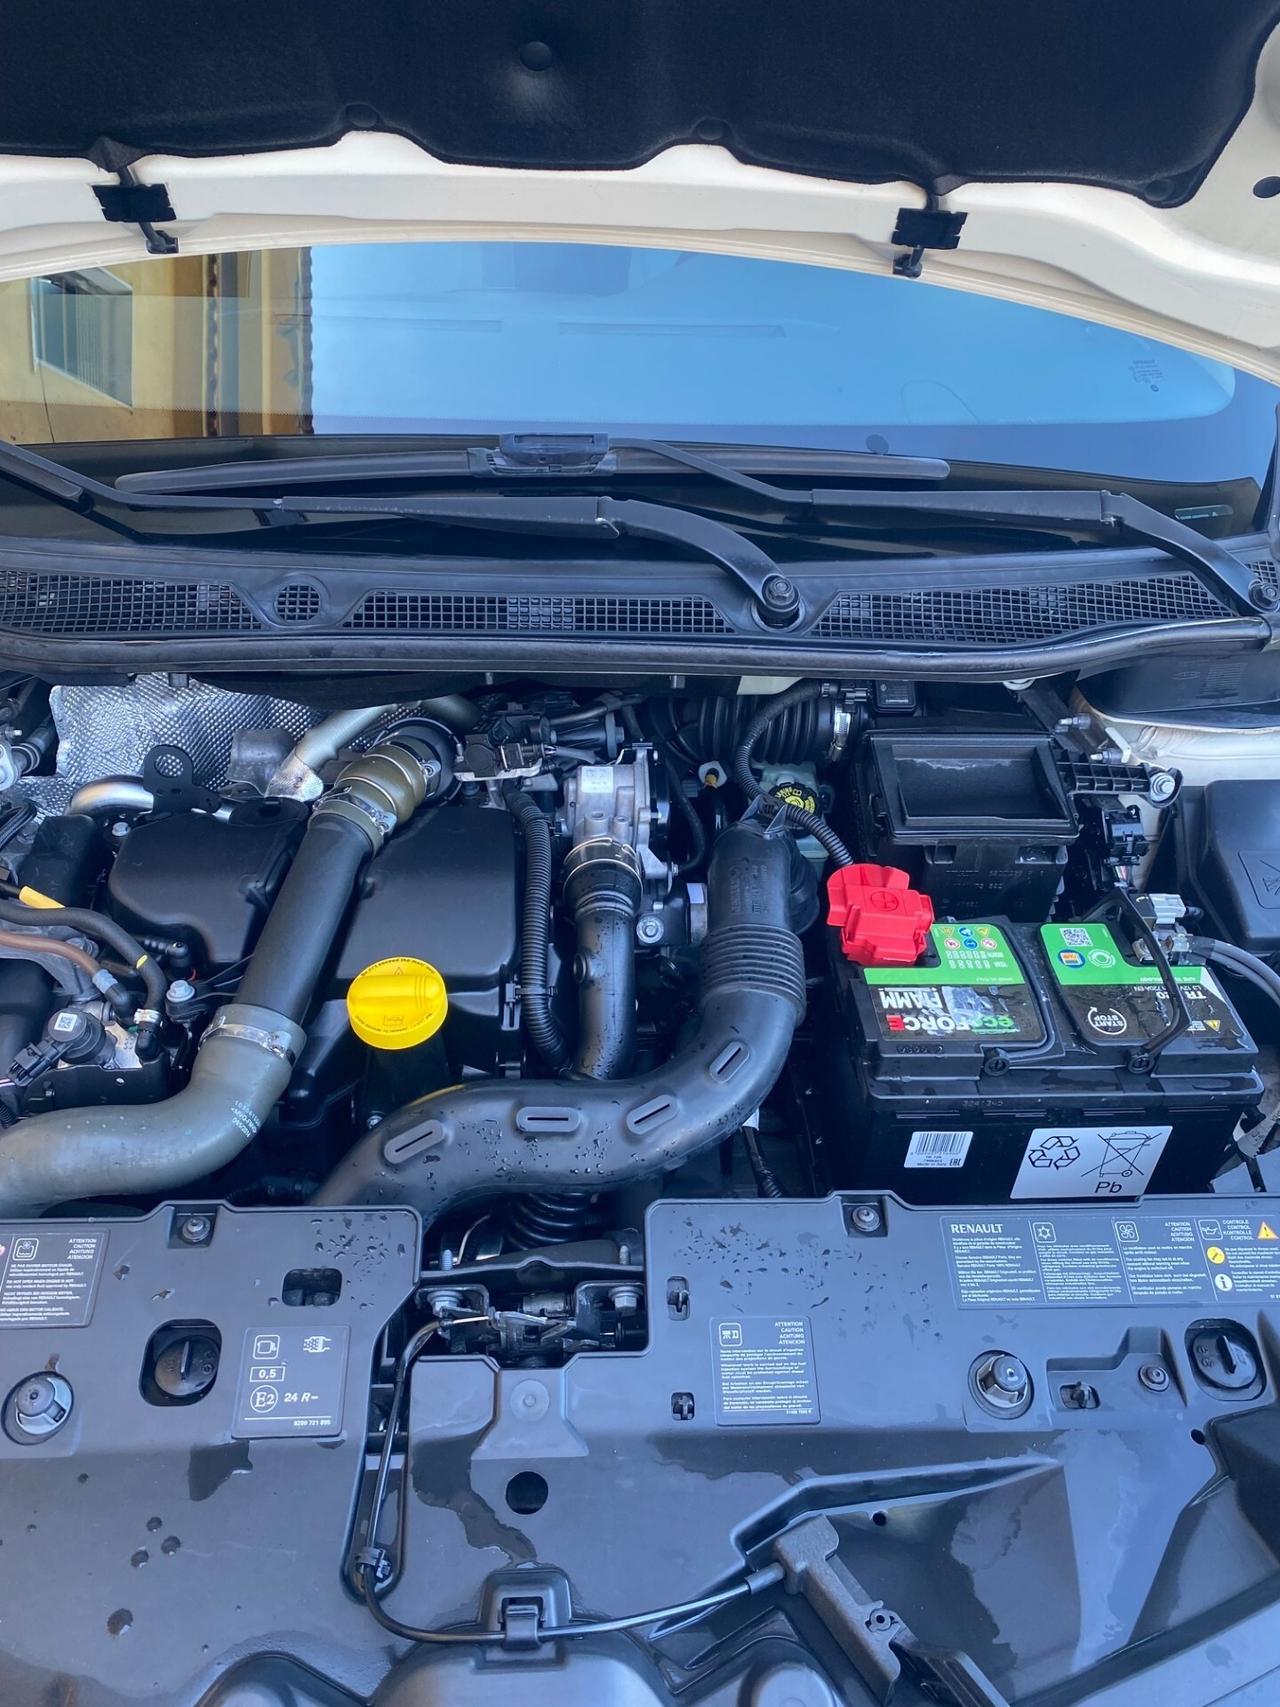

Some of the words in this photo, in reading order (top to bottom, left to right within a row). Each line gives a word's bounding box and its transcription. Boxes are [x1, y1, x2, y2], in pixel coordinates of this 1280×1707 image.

[879, 989, 943, 1009] FIAMM
[1185, 991, 1207, 999] TR
[1095, 1181, 1121, 1194] Pb
[951, 1223, 1003, 1234] RENAULT
[259, 1369, 277, 1379] 0,5
[255, 1391, 275, 1407] E2
[284, 1393, 298, 1402] 24
